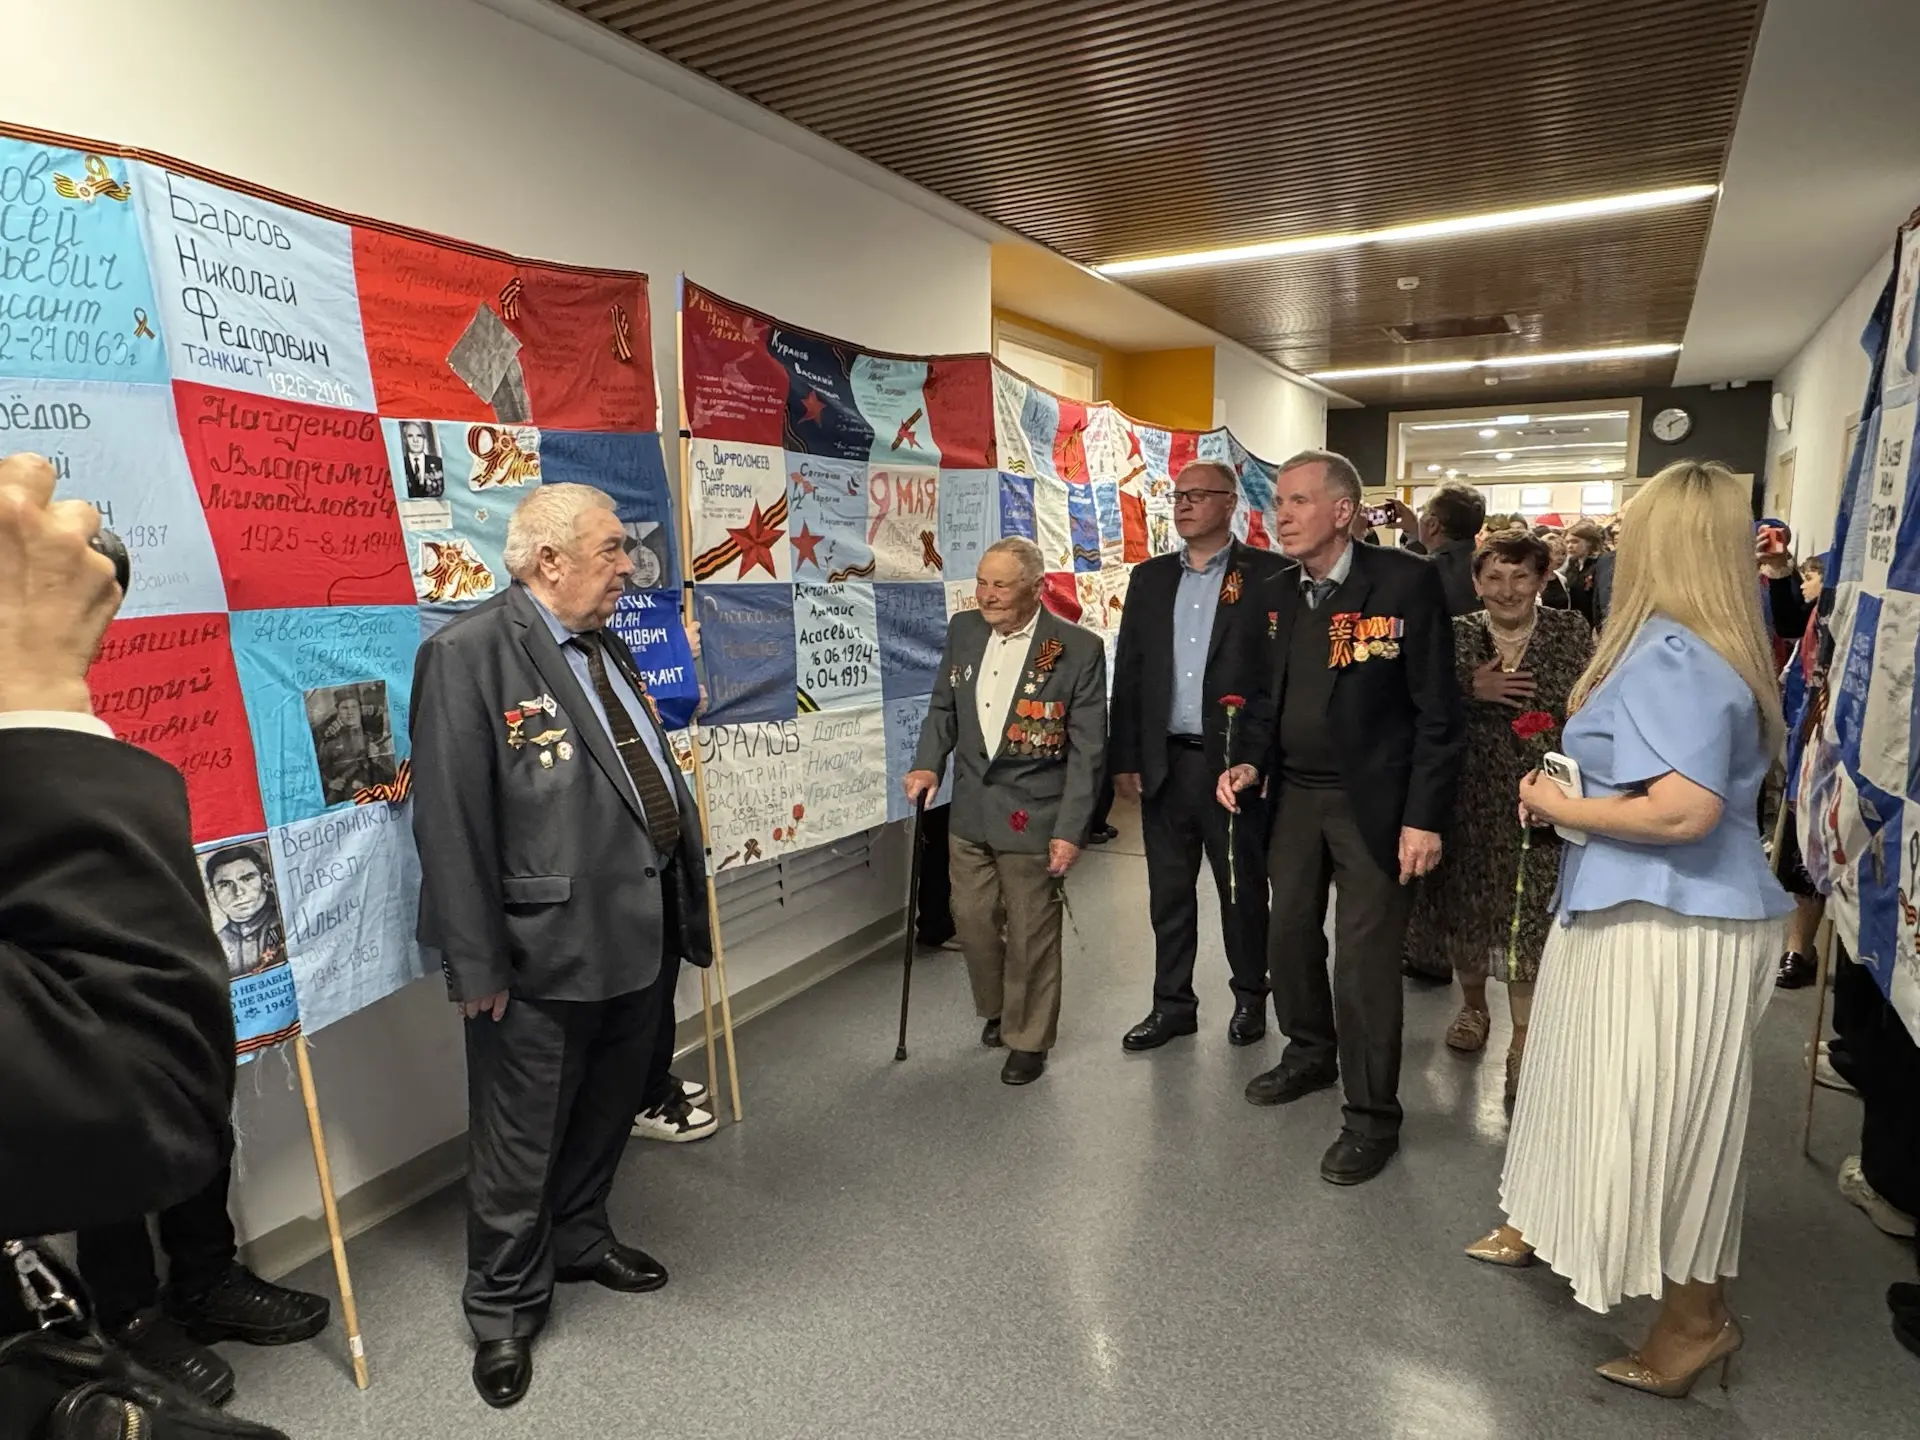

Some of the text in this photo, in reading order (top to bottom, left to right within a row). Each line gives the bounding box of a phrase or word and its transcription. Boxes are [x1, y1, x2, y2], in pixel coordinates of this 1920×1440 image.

[164, 170, 292, 250] Барсов
[0, 243, 124, 290] ьевич
[174, 233, 298, 307] Николай
[266, 371, 354, 407] 1926-2016
[869, 471, 891, 546] 9
[895, 475, 937, 520] МАЯ
[250, 611, 398, 643] Авсюк Денис
[605, 611, 641, 629] ИВАН
[698, 718, 800, 764] УРАЛОВ
[703, 760, 788, 792] ДМИТРИЙ
[708, 782, 803, 813] ВАСИЛЬЕВИЧ
[287, 855, 360, 900] Павел
[238, 995, 256, 1009] НЕ
[240, 983, 257, 996] НЕ
[264, 996, 292, 1014] 1945
